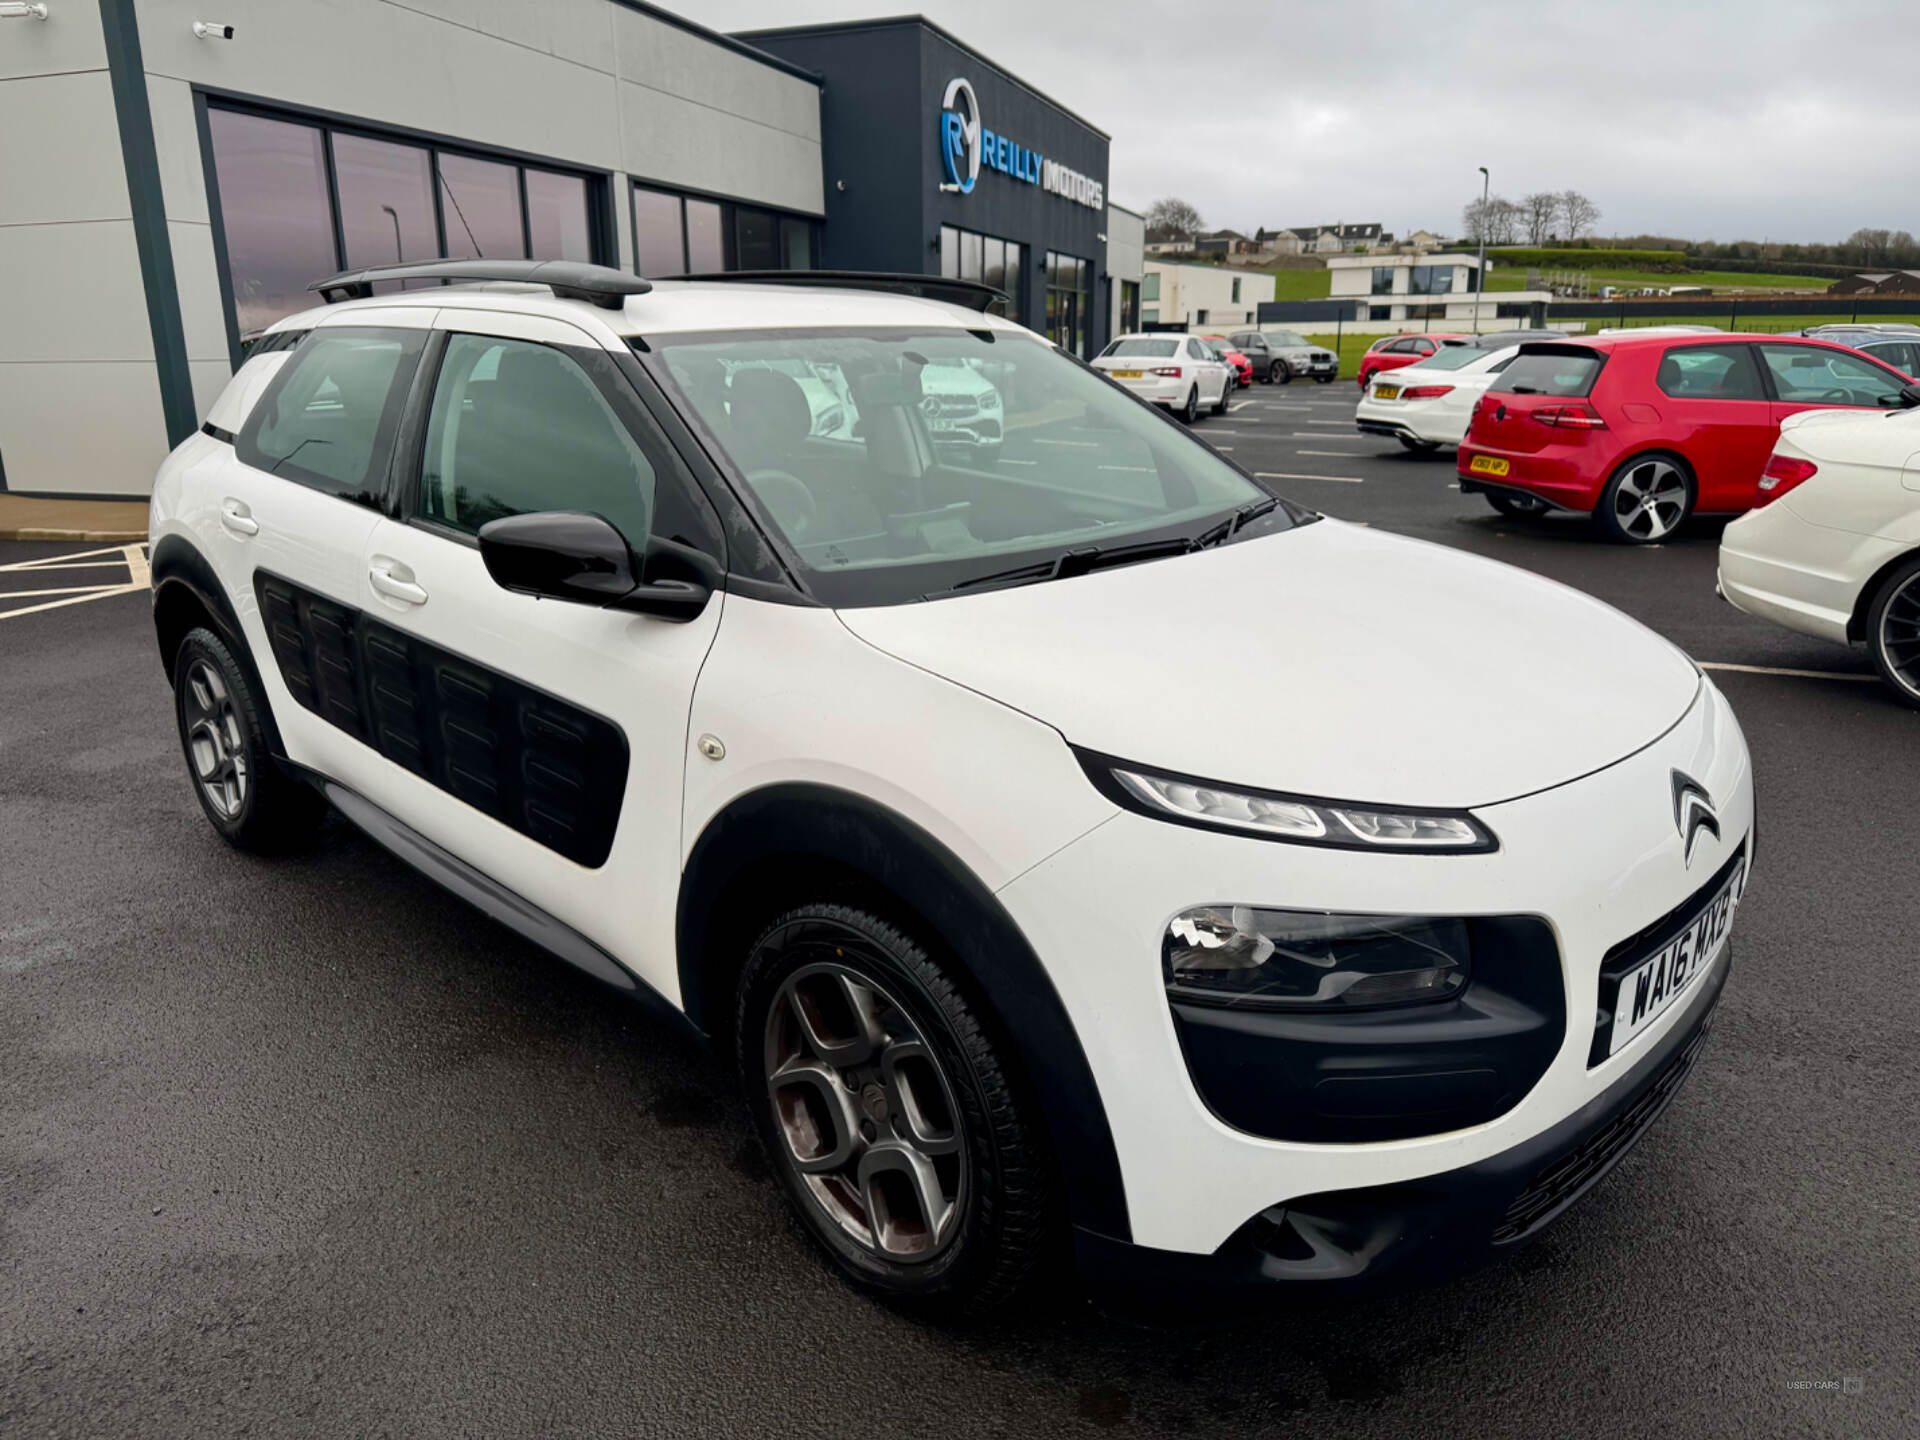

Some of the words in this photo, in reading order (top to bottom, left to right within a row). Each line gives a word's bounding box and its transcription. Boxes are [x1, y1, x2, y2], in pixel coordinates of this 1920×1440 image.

[981, 128, 1043, 185] REILLY
[1043, 159, 1103, 210] MOTORS
[1631, 931, 1692, 1027] WA16
